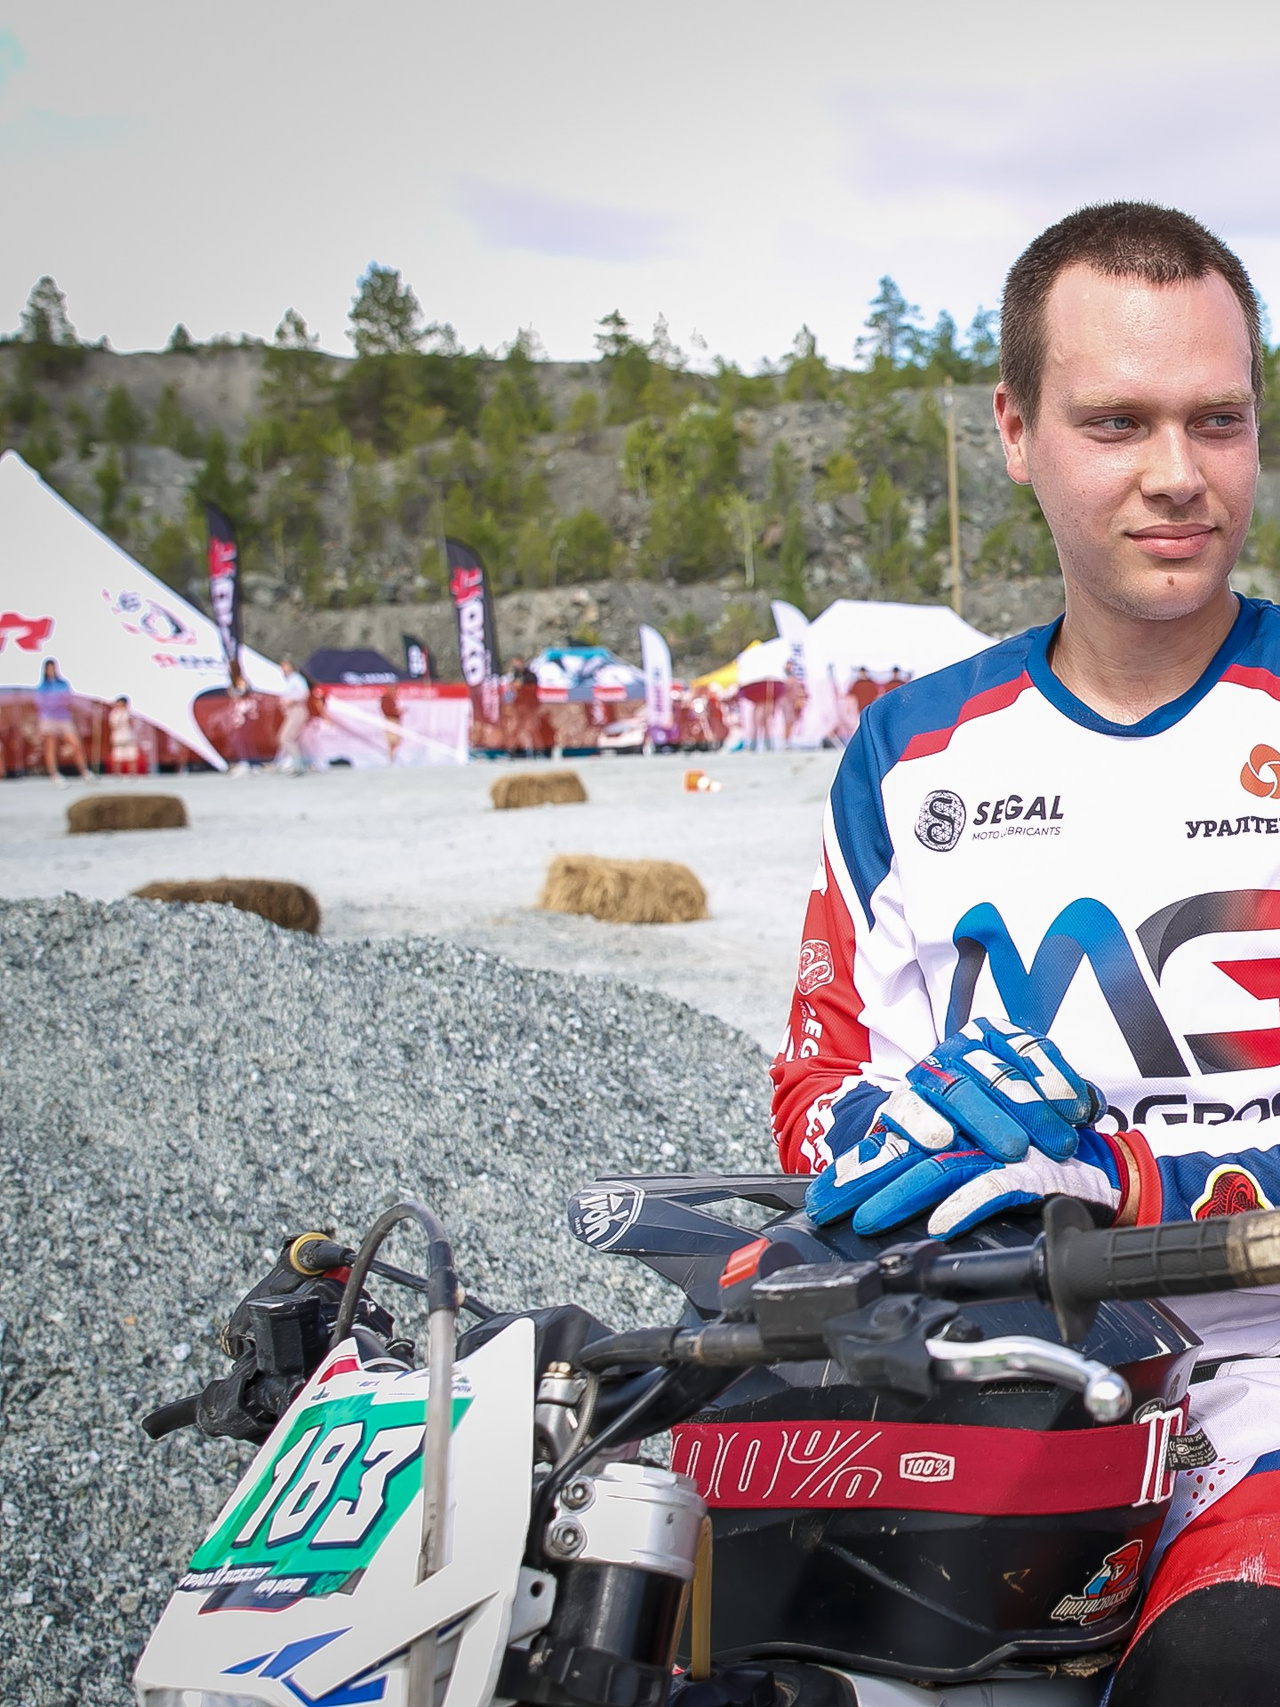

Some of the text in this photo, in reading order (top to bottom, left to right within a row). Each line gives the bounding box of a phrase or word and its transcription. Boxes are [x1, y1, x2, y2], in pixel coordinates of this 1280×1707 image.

[972, 794, 1064, 826] SEGAL
[971, 830, 999, 841] MOTO
[904, 1457, 950, 1477] 100%
[232, 1421, 427, 1548] 183
